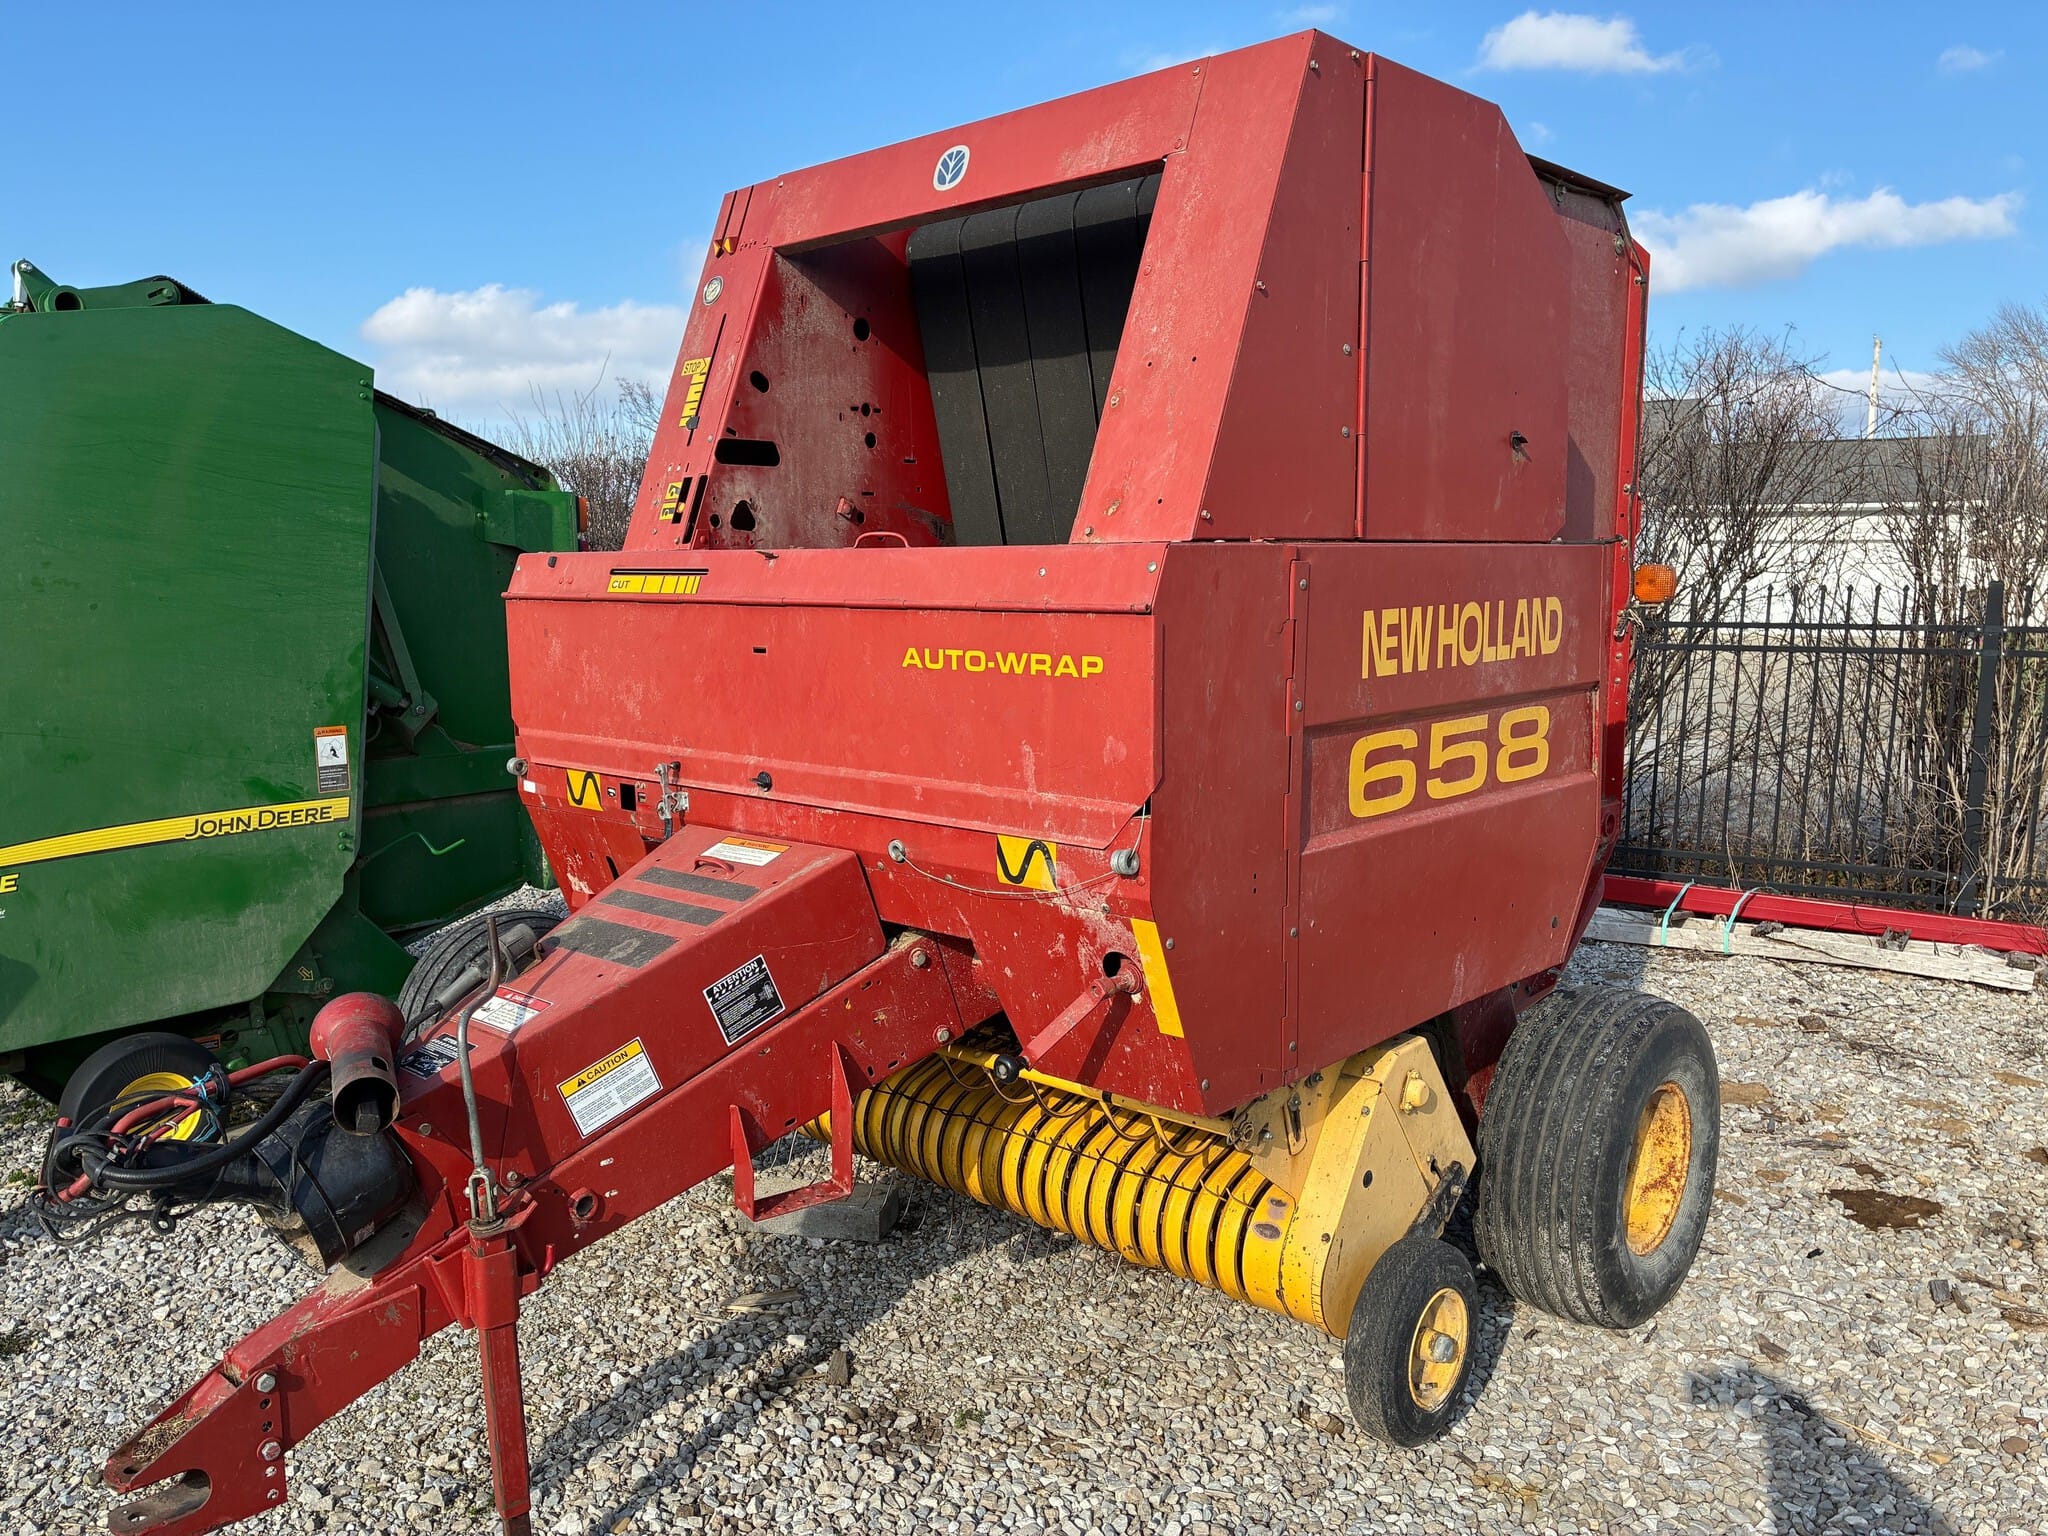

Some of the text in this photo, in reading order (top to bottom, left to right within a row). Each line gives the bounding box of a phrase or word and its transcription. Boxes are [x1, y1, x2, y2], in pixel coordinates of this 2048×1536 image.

[683, 361, 701, 374] STOP
[611, 580, 630, 589] CUT
[1361, 596, 1563, 679] NEW HOLLAND
[902, 647, 1104, 678] AUTO-WRAP
[1349, 705, 1550, 818] 658
[185, 806, 332, 837] JOHN DEERE
[712, 961, 758, 994] ATTENTION
[586, 1050, 628, 1080] CAUTION
